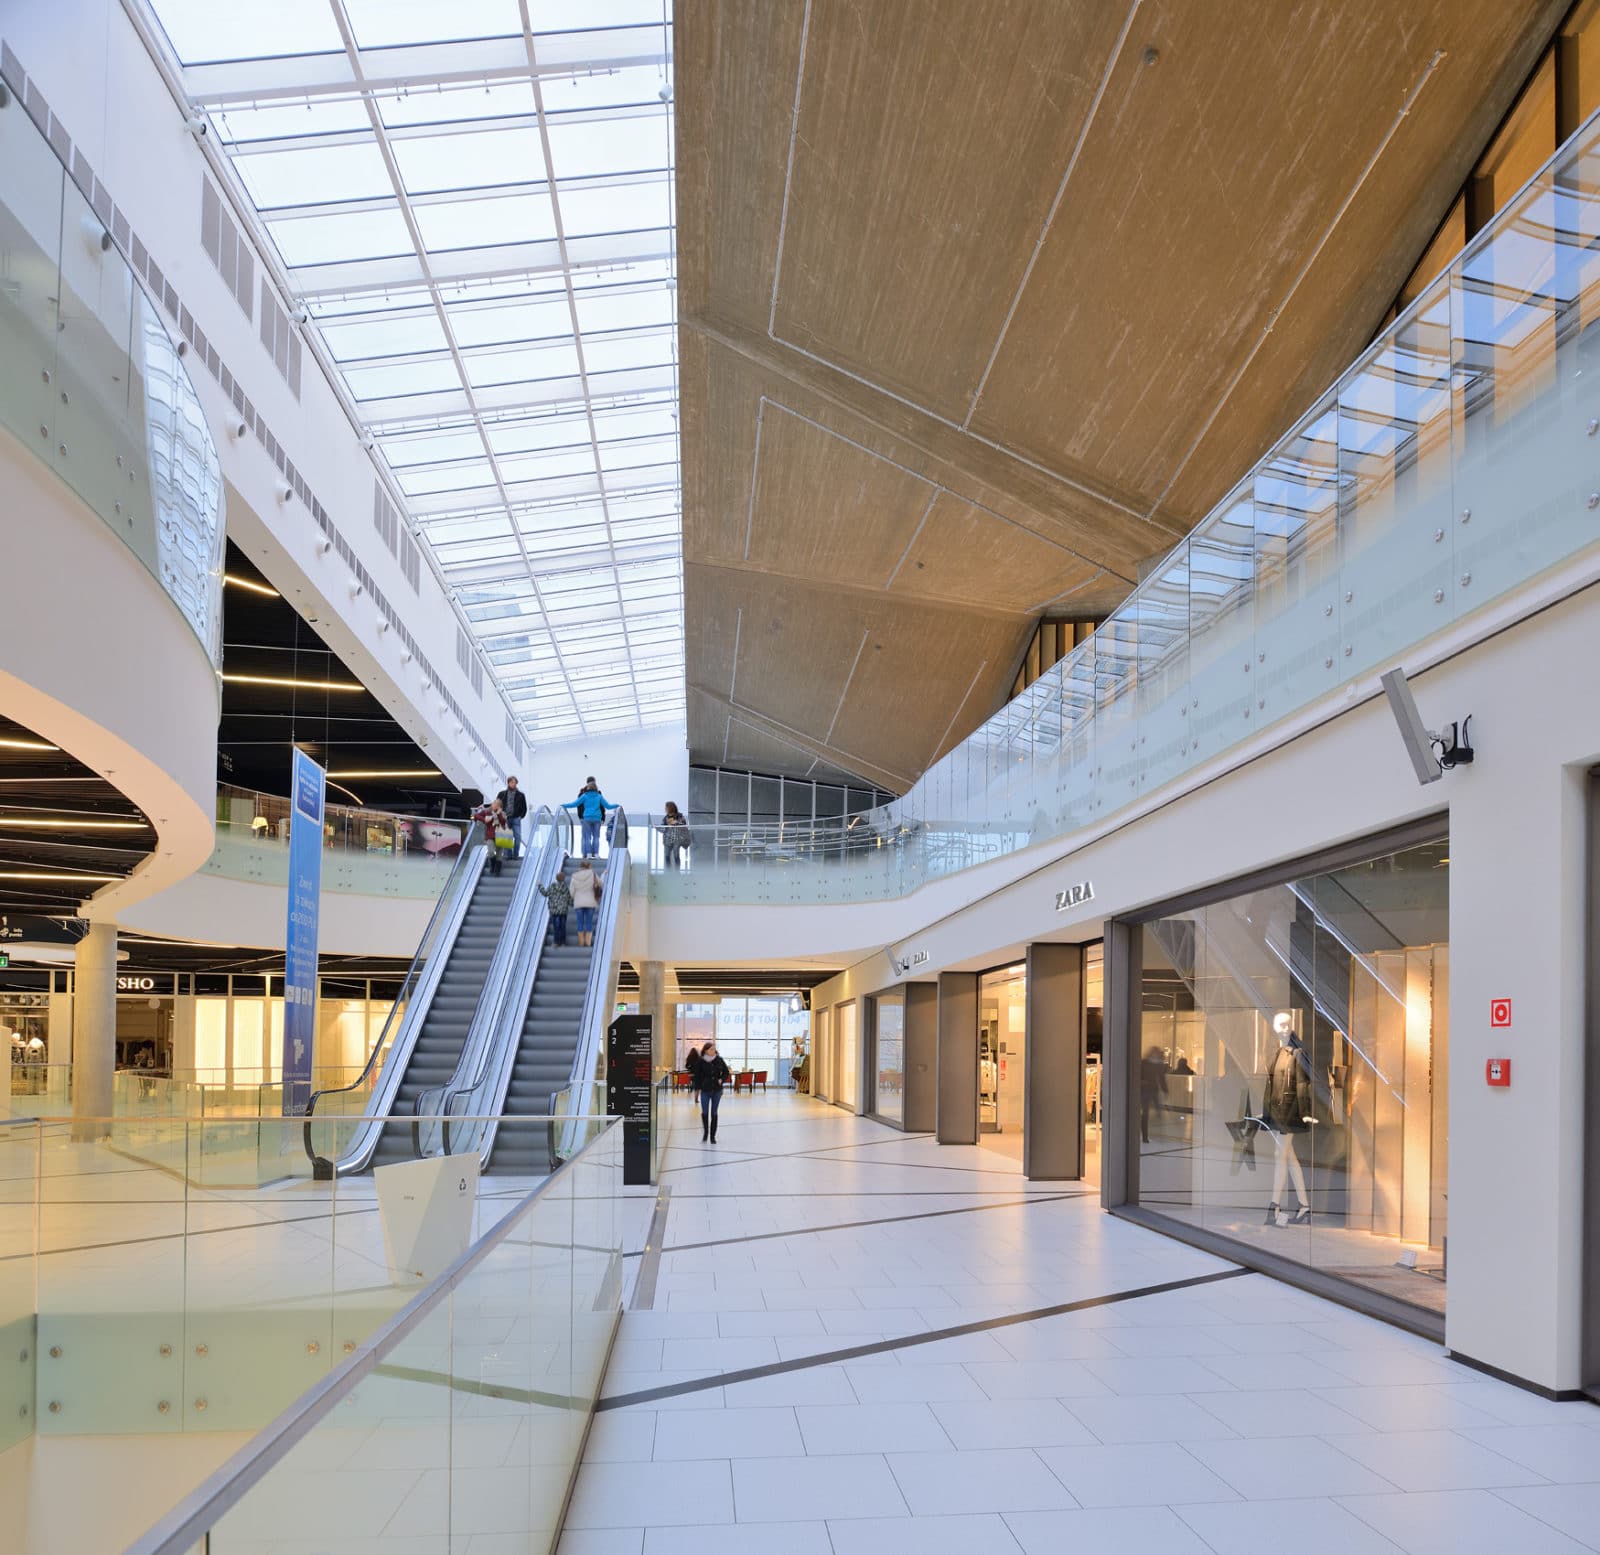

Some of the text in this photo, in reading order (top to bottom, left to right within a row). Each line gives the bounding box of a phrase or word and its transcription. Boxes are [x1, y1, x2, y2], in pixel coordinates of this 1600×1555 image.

[1055, 881, 1094, 911] ZARA
[115, 976, 154, 990] SHO
[611, 1028, 616, 1036] 3
[611, 1037, 616, 1045] 2
[611, 1059, 616, 1067] 1
